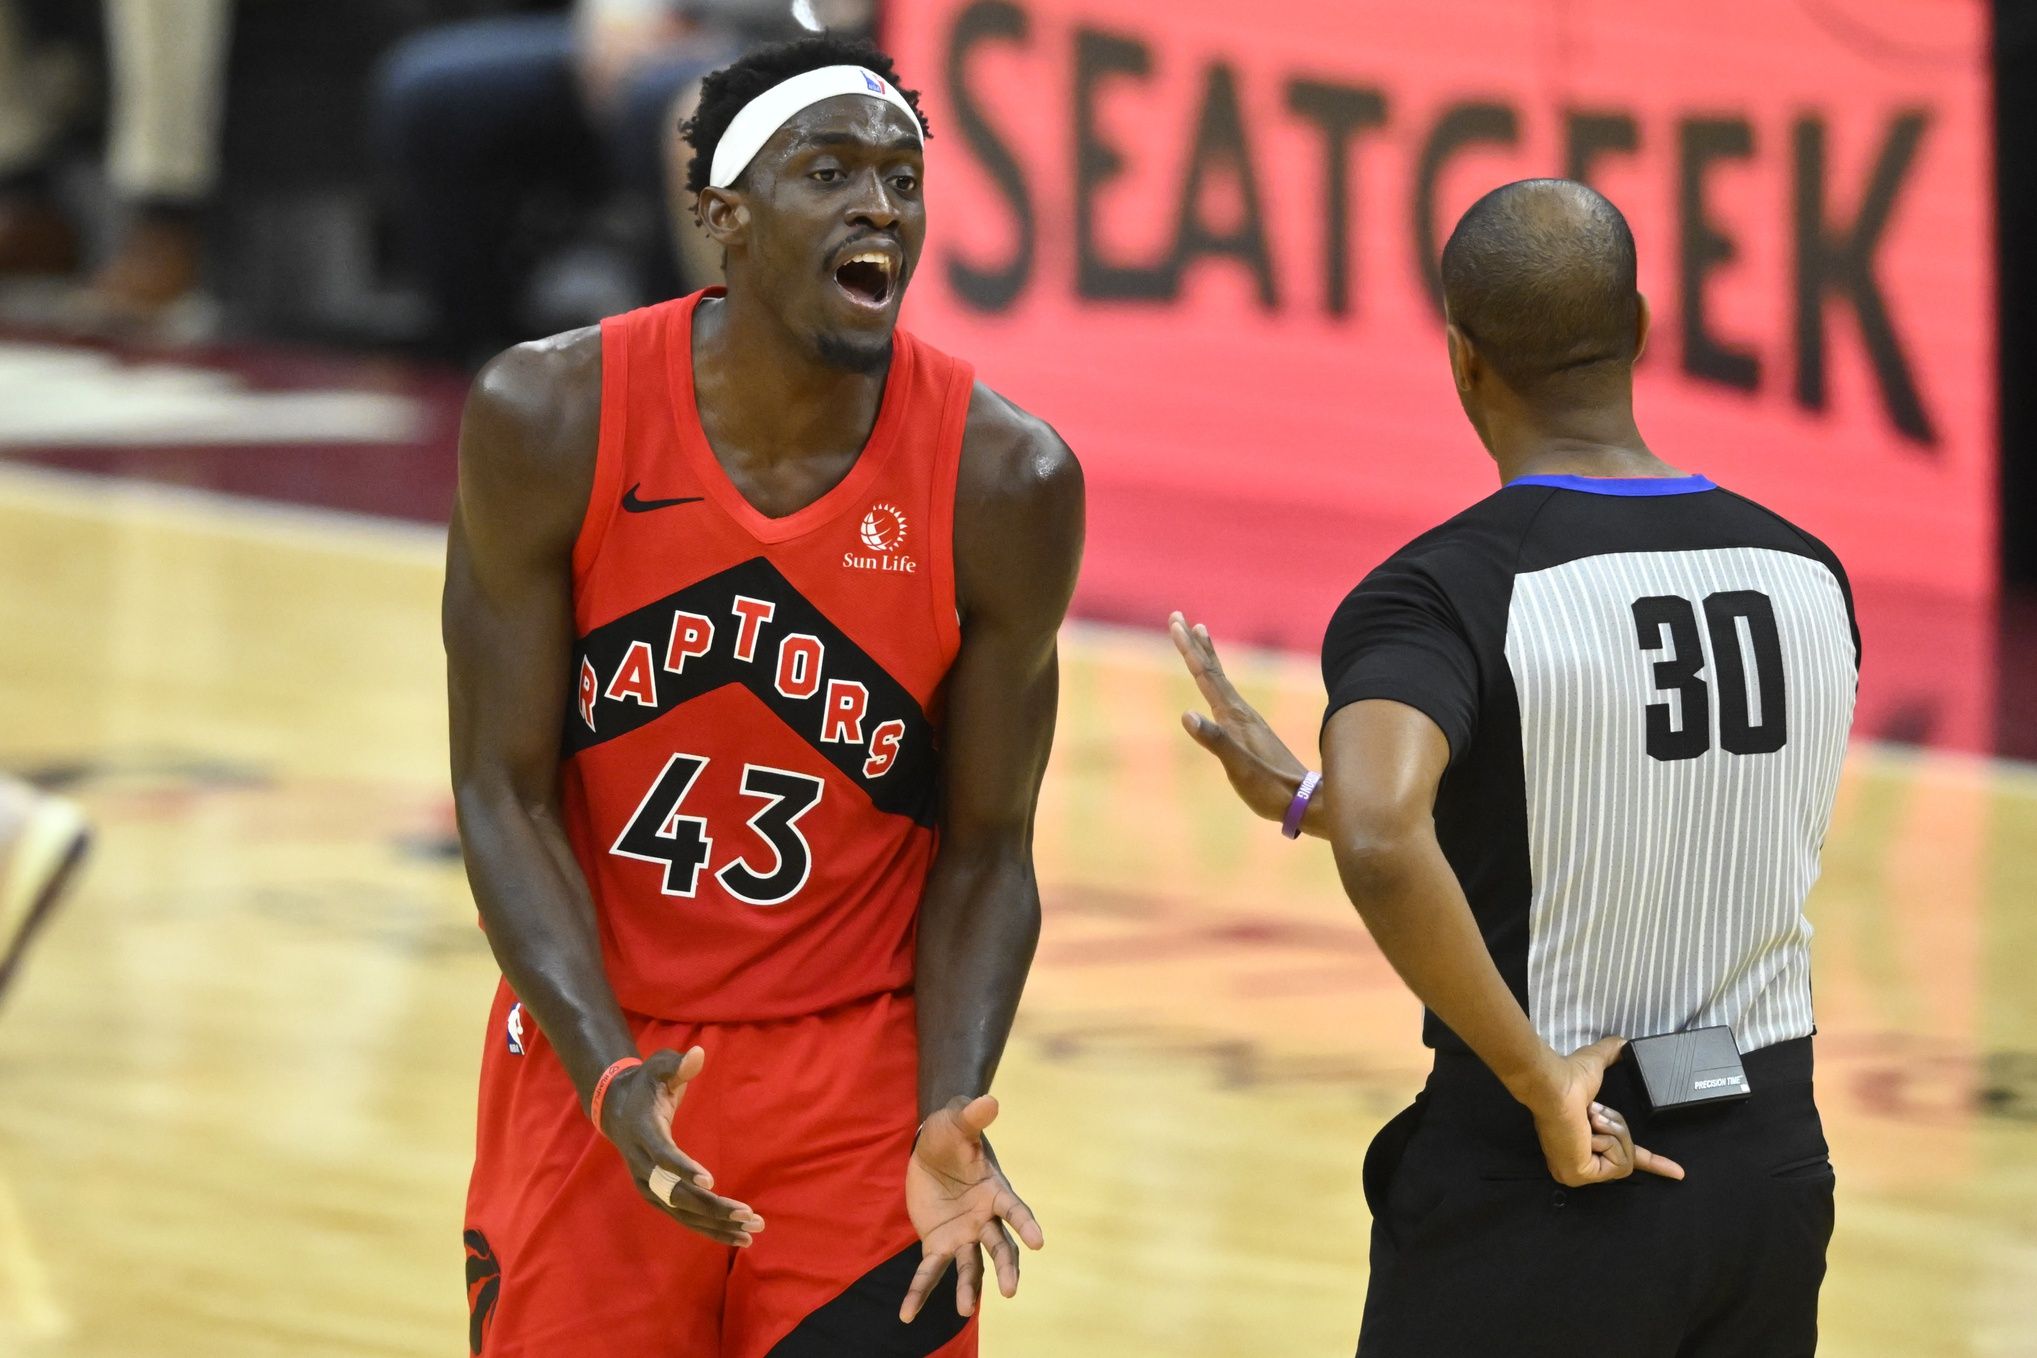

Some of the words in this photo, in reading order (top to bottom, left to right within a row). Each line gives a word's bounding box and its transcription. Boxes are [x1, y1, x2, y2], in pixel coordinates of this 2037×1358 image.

[843, 552, 877, 569] Sun
[882, 555, 916, 573] Life
[578, 595, 906, 779] RAPTORS
[1631, 590, 1787, 761] 30
[609, 752, 825, 905] 43
[1694, 1077, 1726, 1090] PRECISION
